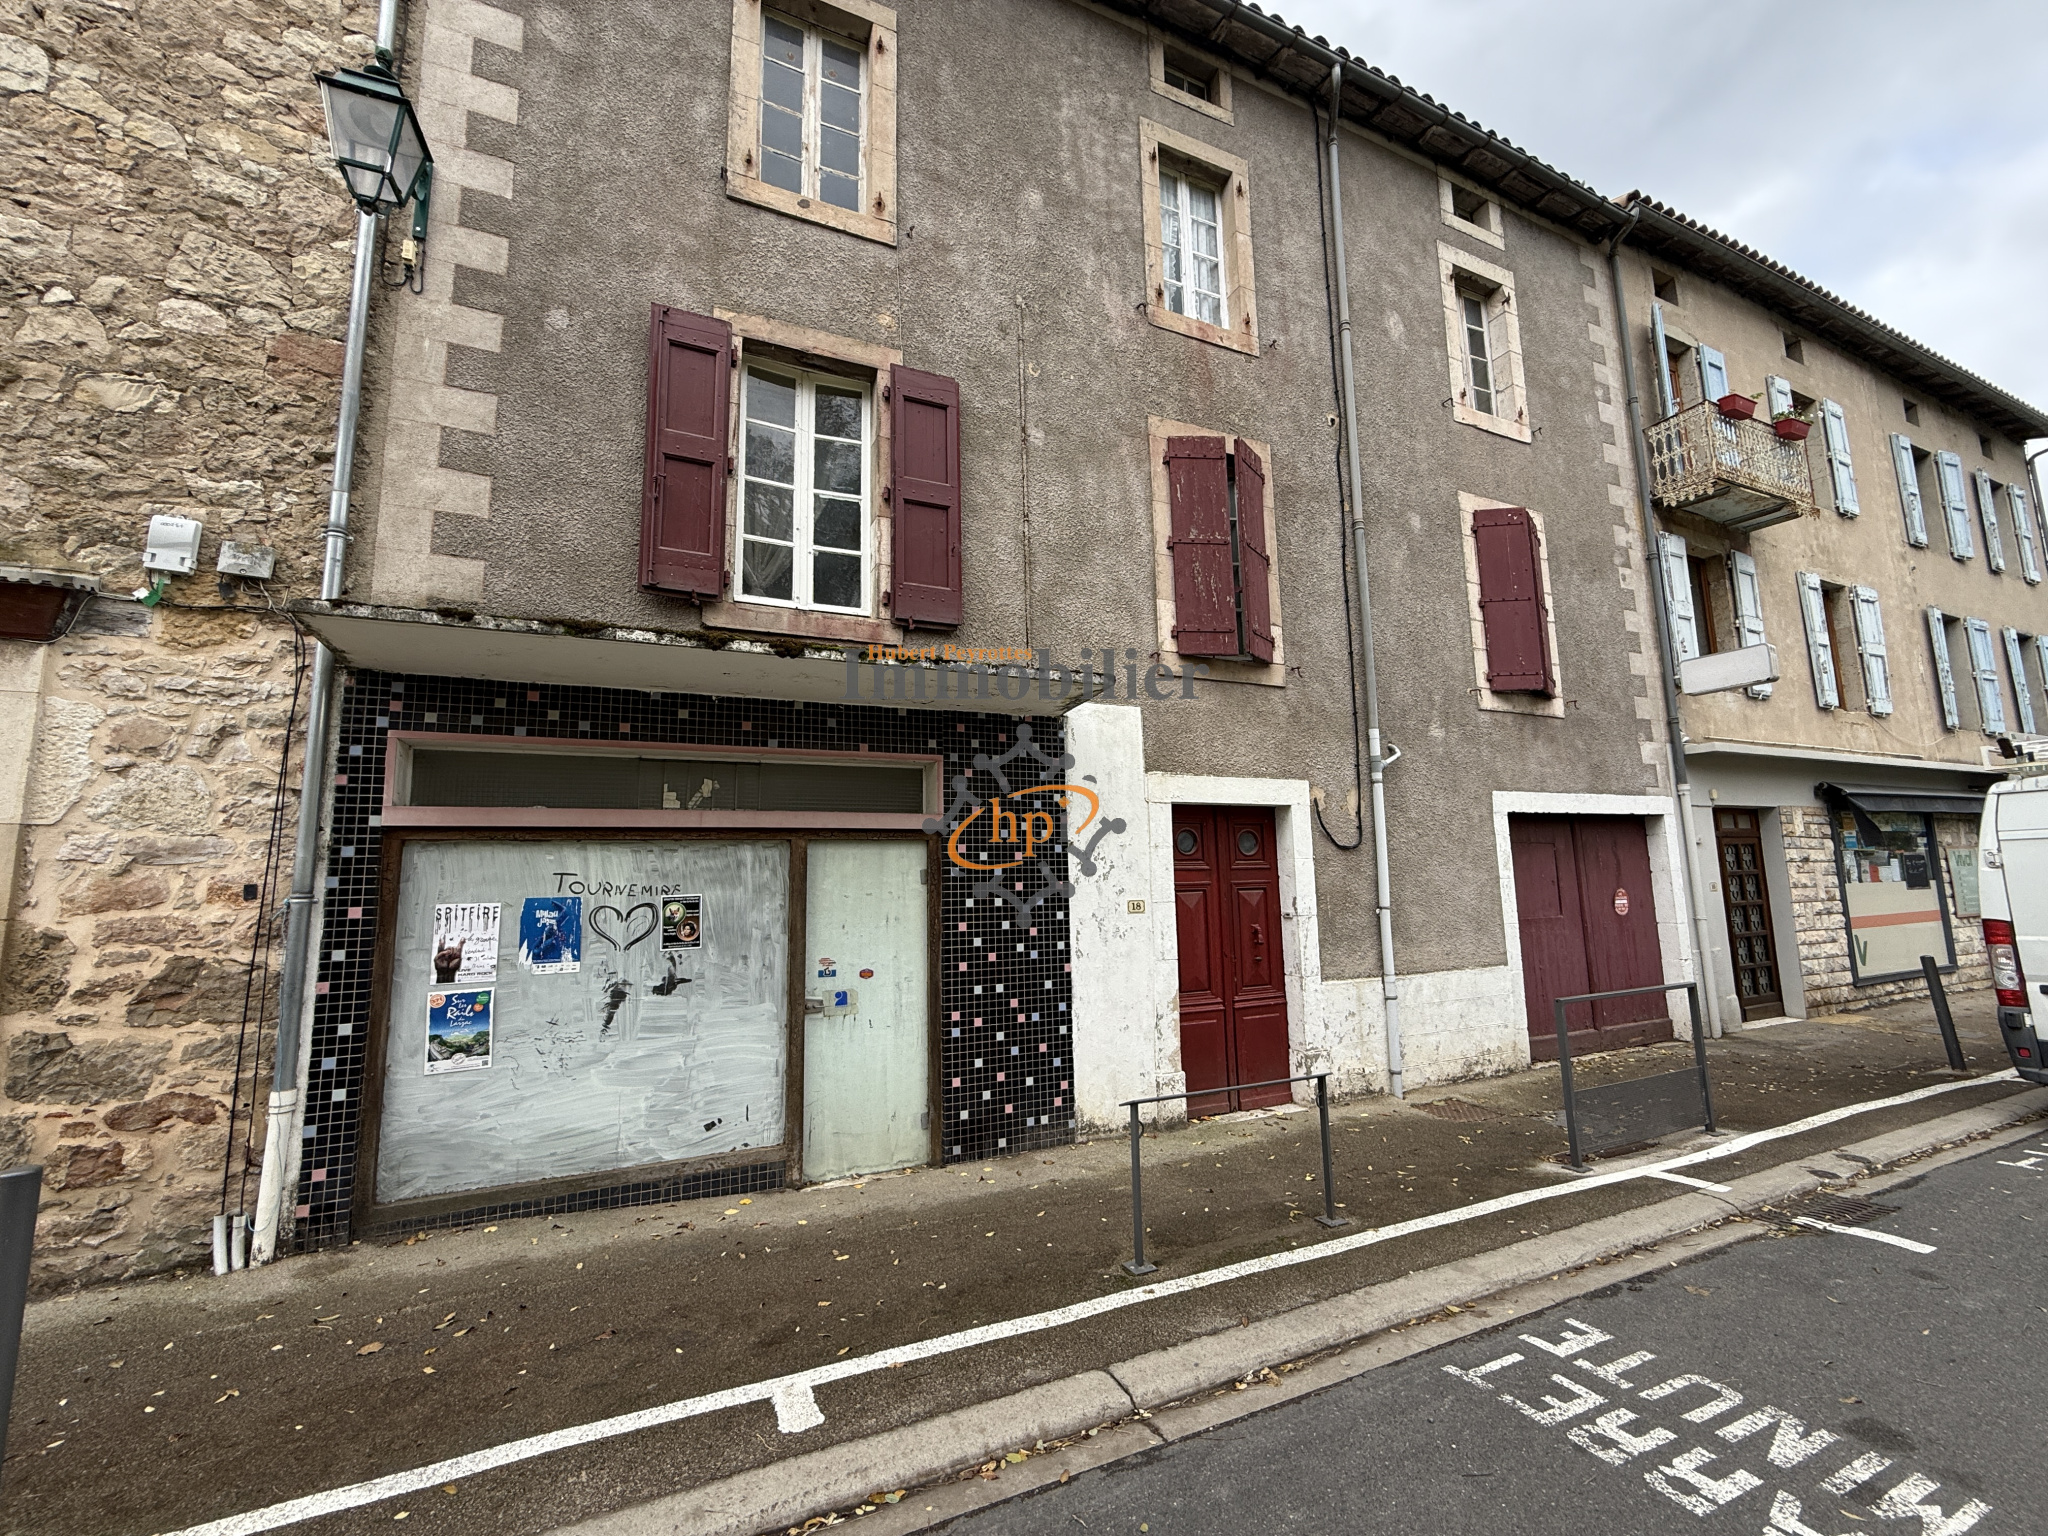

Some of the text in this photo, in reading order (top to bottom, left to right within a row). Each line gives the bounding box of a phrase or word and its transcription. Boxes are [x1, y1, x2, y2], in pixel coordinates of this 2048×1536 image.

[1131, 902, 1142, 911] 18
[446, 1004, 475, 1020] Rails
[1518, 1317, 1994, 1536] MINUTE
